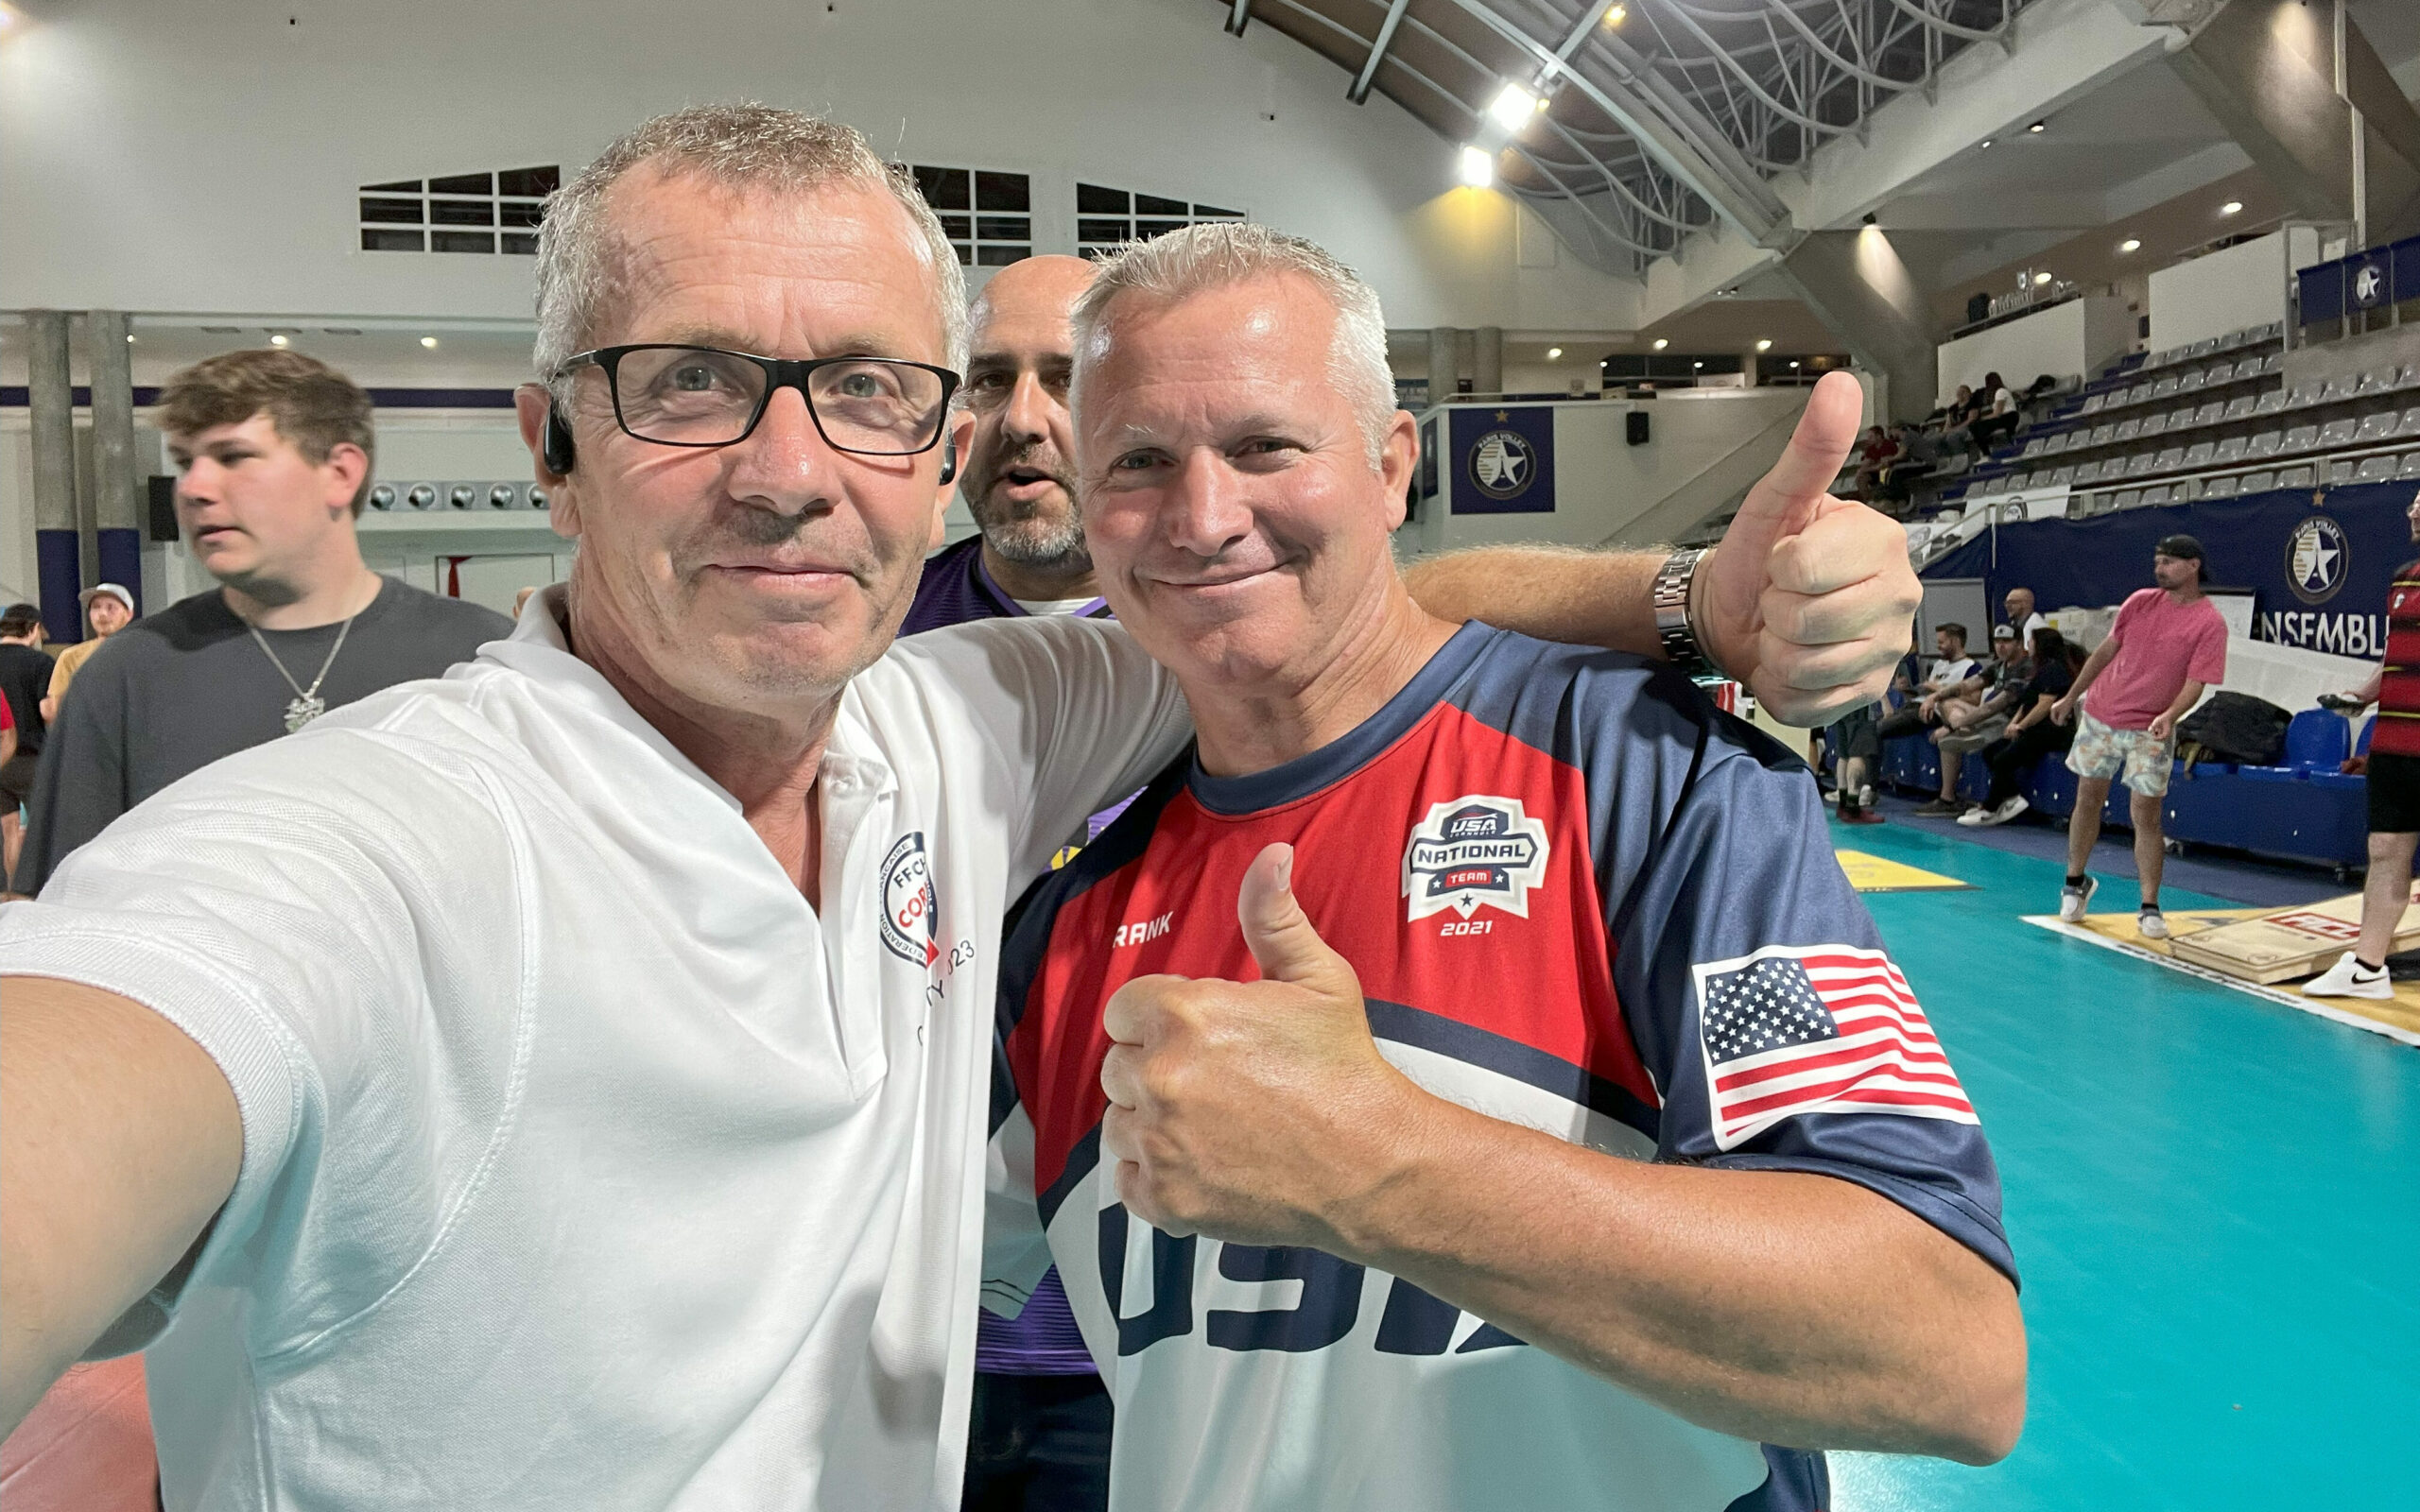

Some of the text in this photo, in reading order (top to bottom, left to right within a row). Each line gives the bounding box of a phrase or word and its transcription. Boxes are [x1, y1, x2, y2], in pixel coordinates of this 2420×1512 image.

[2254, 610, 2390, 657] NSEMBL
[1449, 818, 1497, 833] USA
[1417, 844, 1526, 864] NATIONAL
[1450, 871, 1488, 885] TEAM
[898, 881, 928, 929] COR
[880, 913, 927, 960] EDERATION
[1440, 919, 1494, 937] 2021
